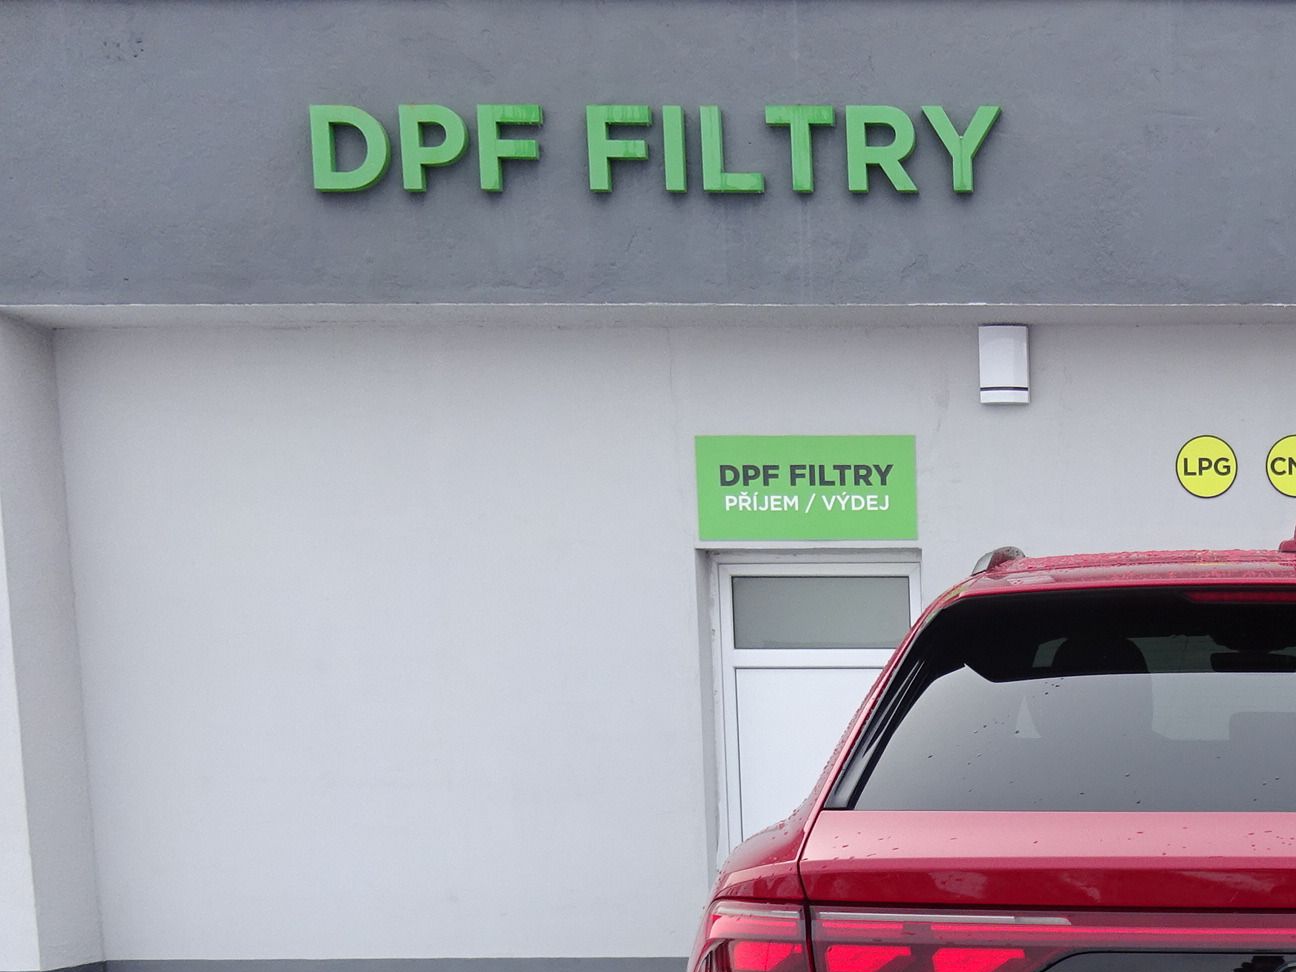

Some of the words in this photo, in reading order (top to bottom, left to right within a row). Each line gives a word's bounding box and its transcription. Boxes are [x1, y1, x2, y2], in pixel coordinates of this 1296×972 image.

[309, 104, 543, 193] DPF
[586, 104, 1001, 193] FILTRY
[719, 464, 780, 487] DPF
[789, 464, 894, 486] FILTRY
[1183, 457, 1231, 476] LPG
[725, 492, 799, 511] PŘÍJEM
[805, 493, 816, 513] /
[822, 491, 889, 510] VÝDEJ
